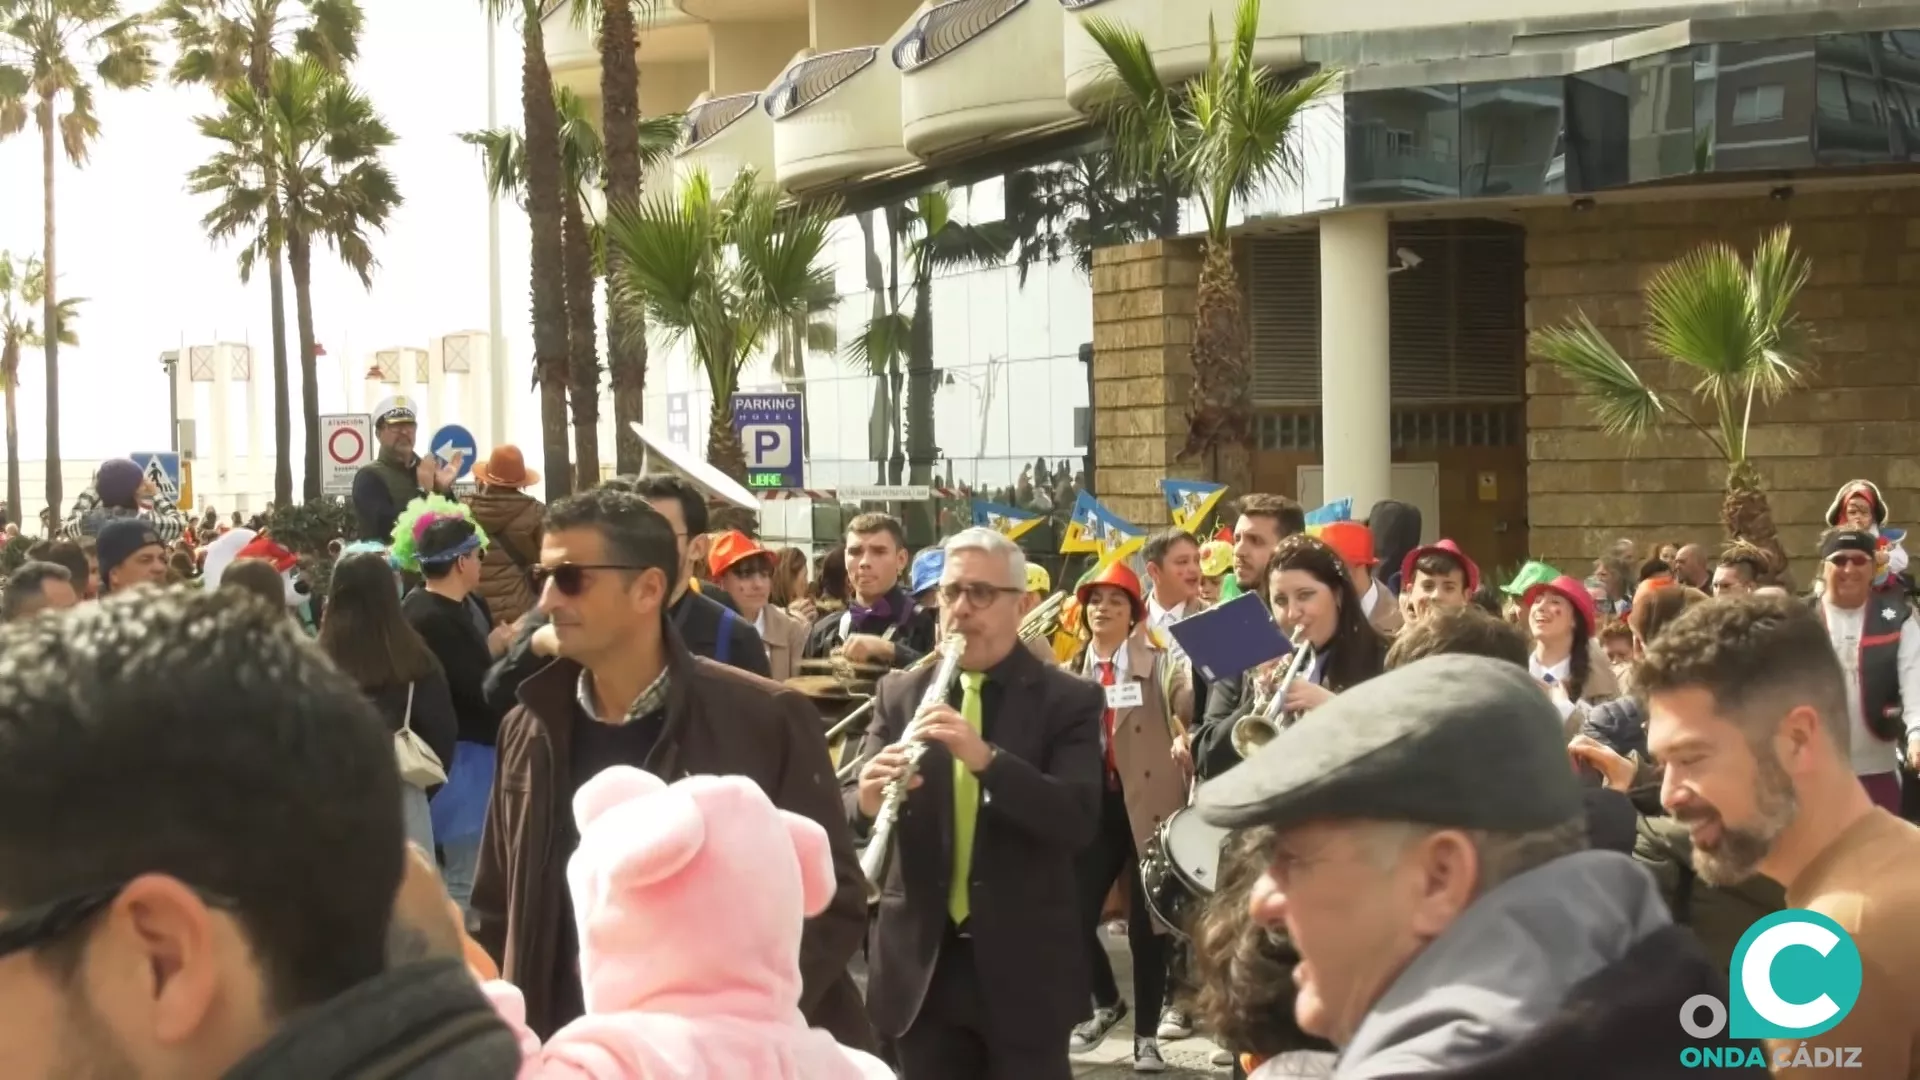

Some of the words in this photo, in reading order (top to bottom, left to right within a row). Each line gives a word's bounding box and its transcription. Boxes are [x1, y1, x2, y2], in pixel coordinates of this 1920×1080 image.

[735, 398, 796, 410] PARKING
[755, 430, 780, 464] P
[748, 473, 782, 486] LIBRE
